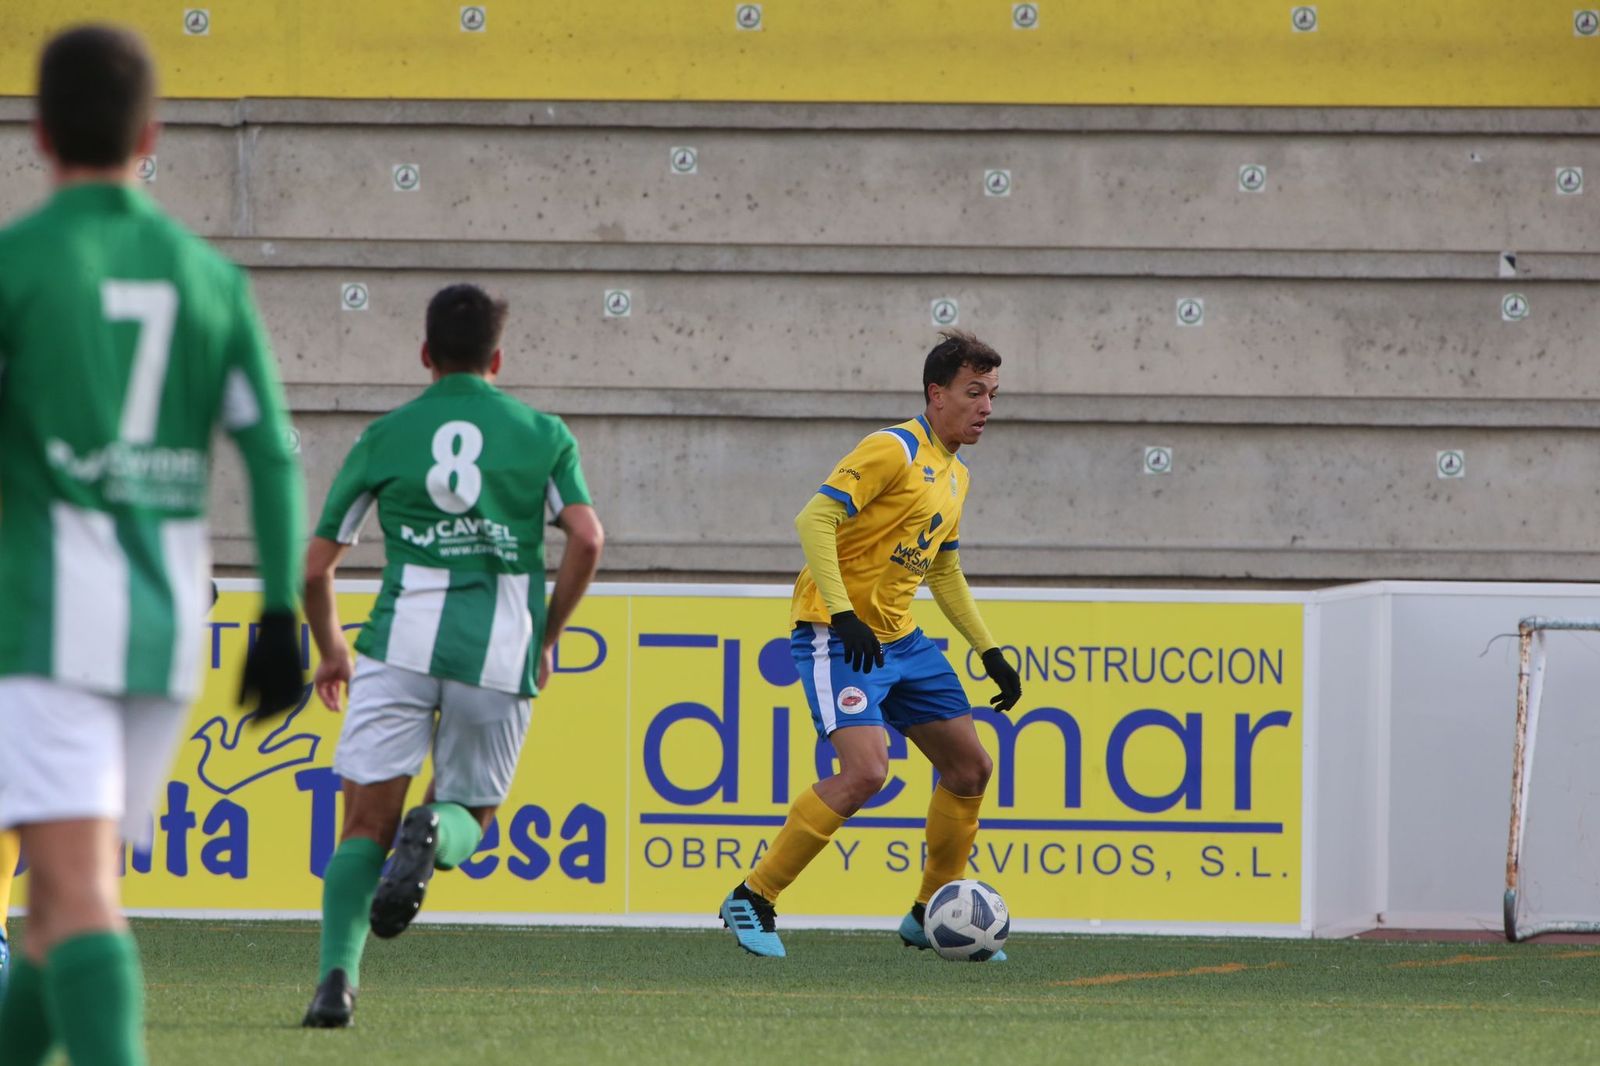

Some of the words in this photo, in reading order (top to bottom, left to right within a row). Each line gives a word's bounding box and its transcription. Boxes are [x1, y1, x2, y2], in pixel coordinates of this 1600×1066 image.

[102, 279, 178, 443] 7
[426, 420, 483, 514] 8
[644, 836, 769, 869] OBRA
[834, 840, 860, 870] Y
[1200, 845, 1288, 878] S.L.
